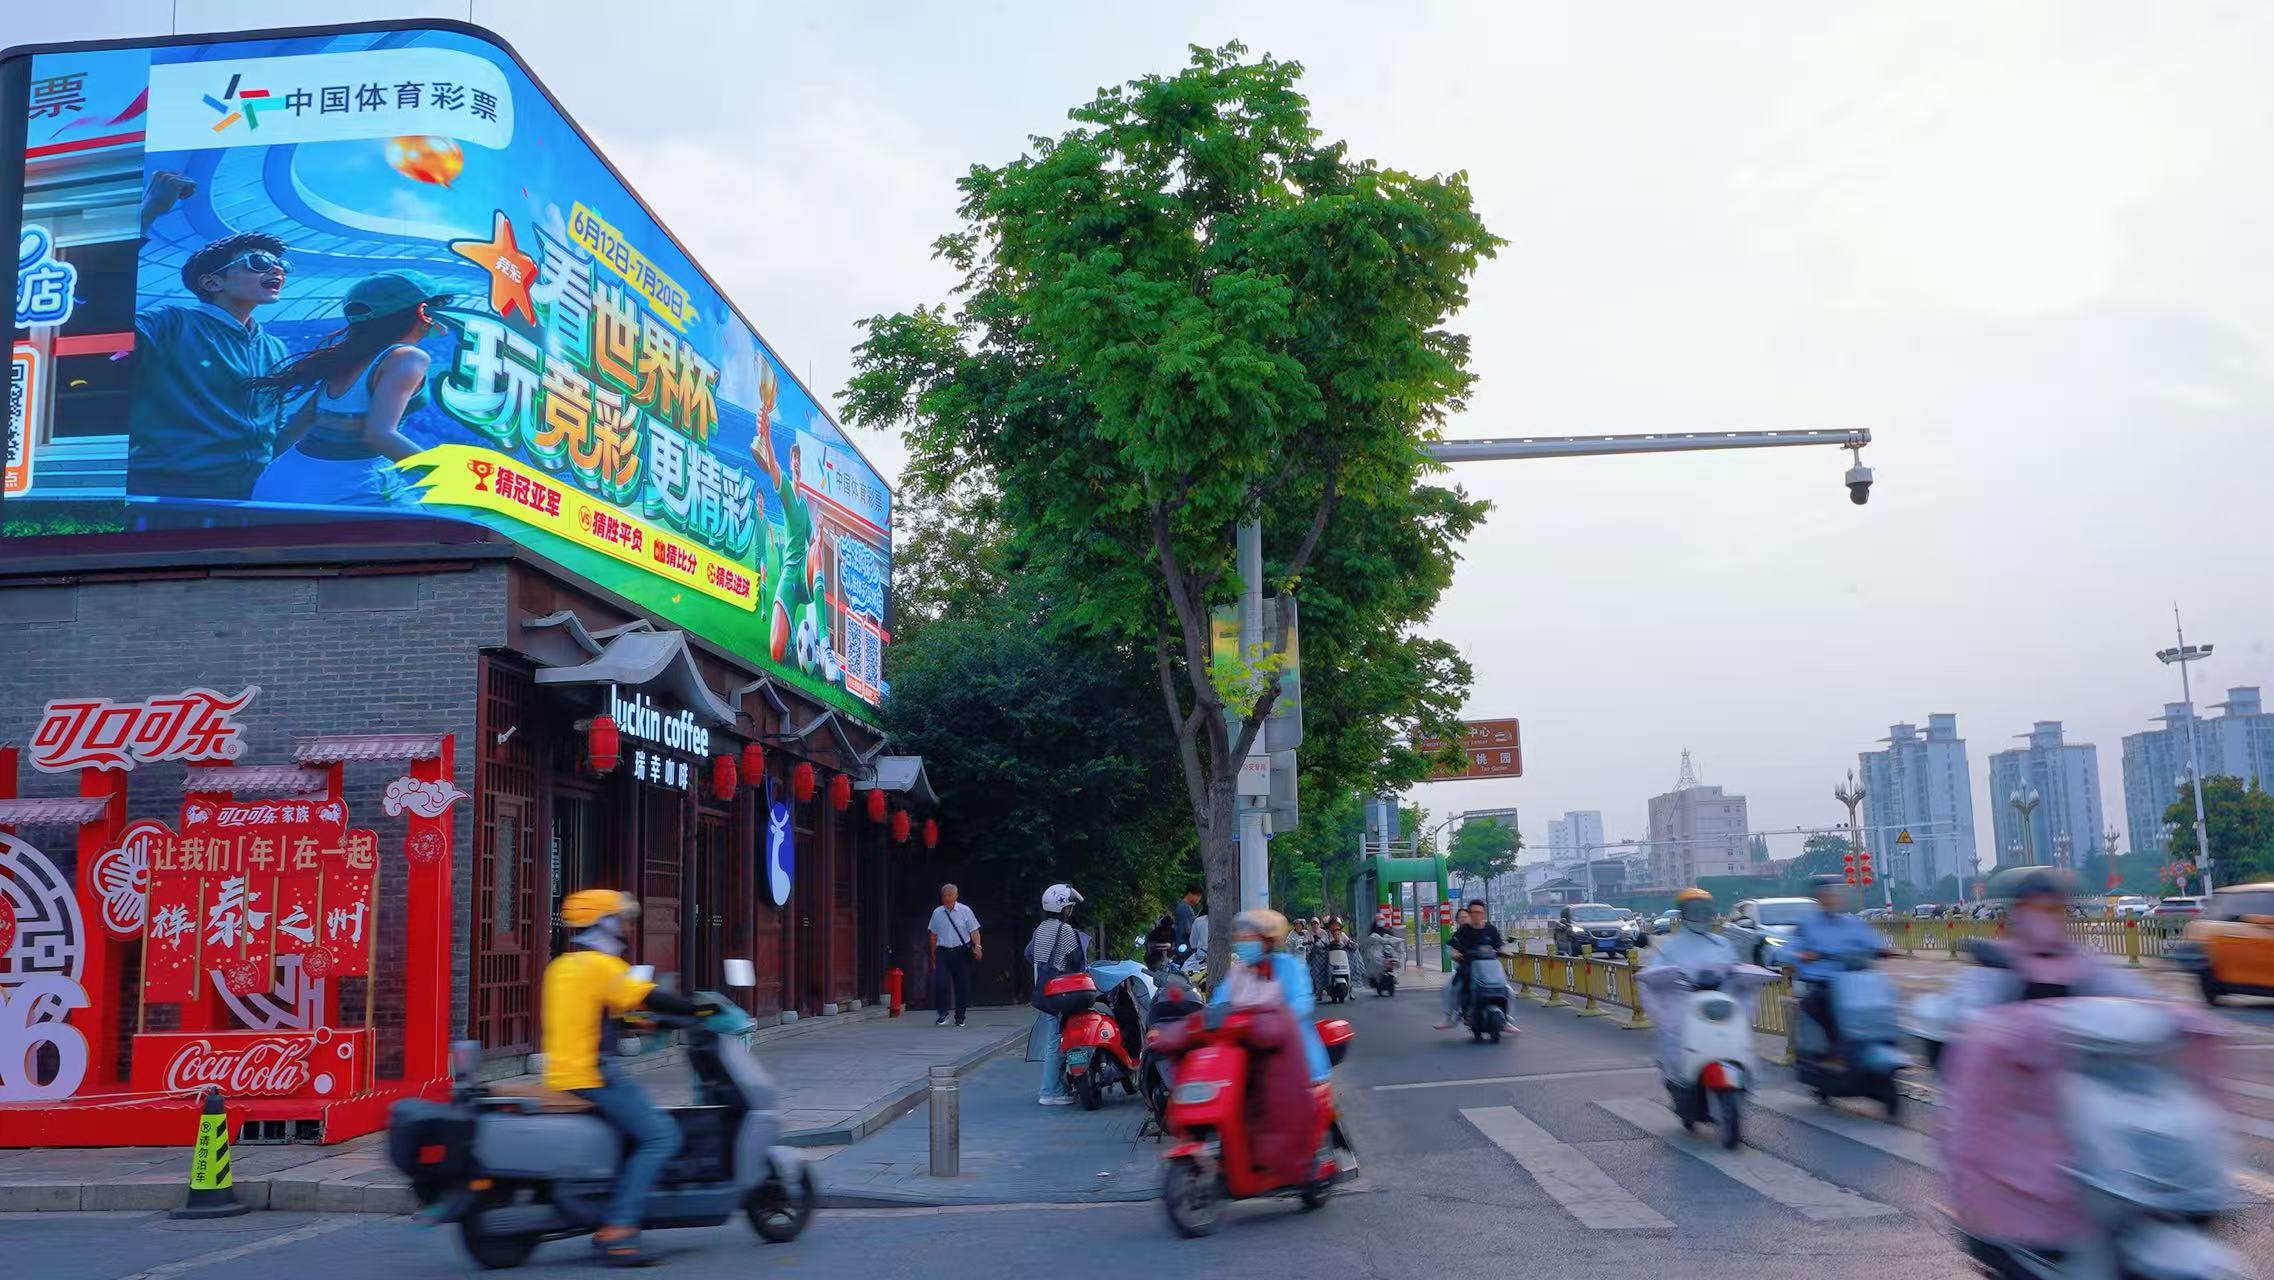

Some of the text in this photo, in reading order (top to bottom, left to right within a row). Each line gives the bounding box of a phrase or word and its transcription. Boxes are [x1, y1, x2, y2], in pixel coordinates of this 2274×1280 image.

[285, 81, 498, 123] 中国体育彩票
[494, 255, 521, 284] 竞彩
[574, 211, 682, 319] 6月12日-7月20日
[530, 225, 721, 442] 看世界杯
[496, 467, 562, 518] 猜冠亚军
[592, 510, 643, 553] 猜胜平负
[666, 543, 698, 575] 猜比分
[716, 566, 751, 598] 猜总进球
[34, 692, 250, 768] 可口可乐
[611, 684, 709, 757] luckin coffee
[634, 751, 689, 790] 瑞幸咖啡
[153, 835, 373, 872] 让我们「年」在一起
[167, 1038, 317, 1097] Coca-Cola
[195, 1135, 209, 1182] 请勿泊车
